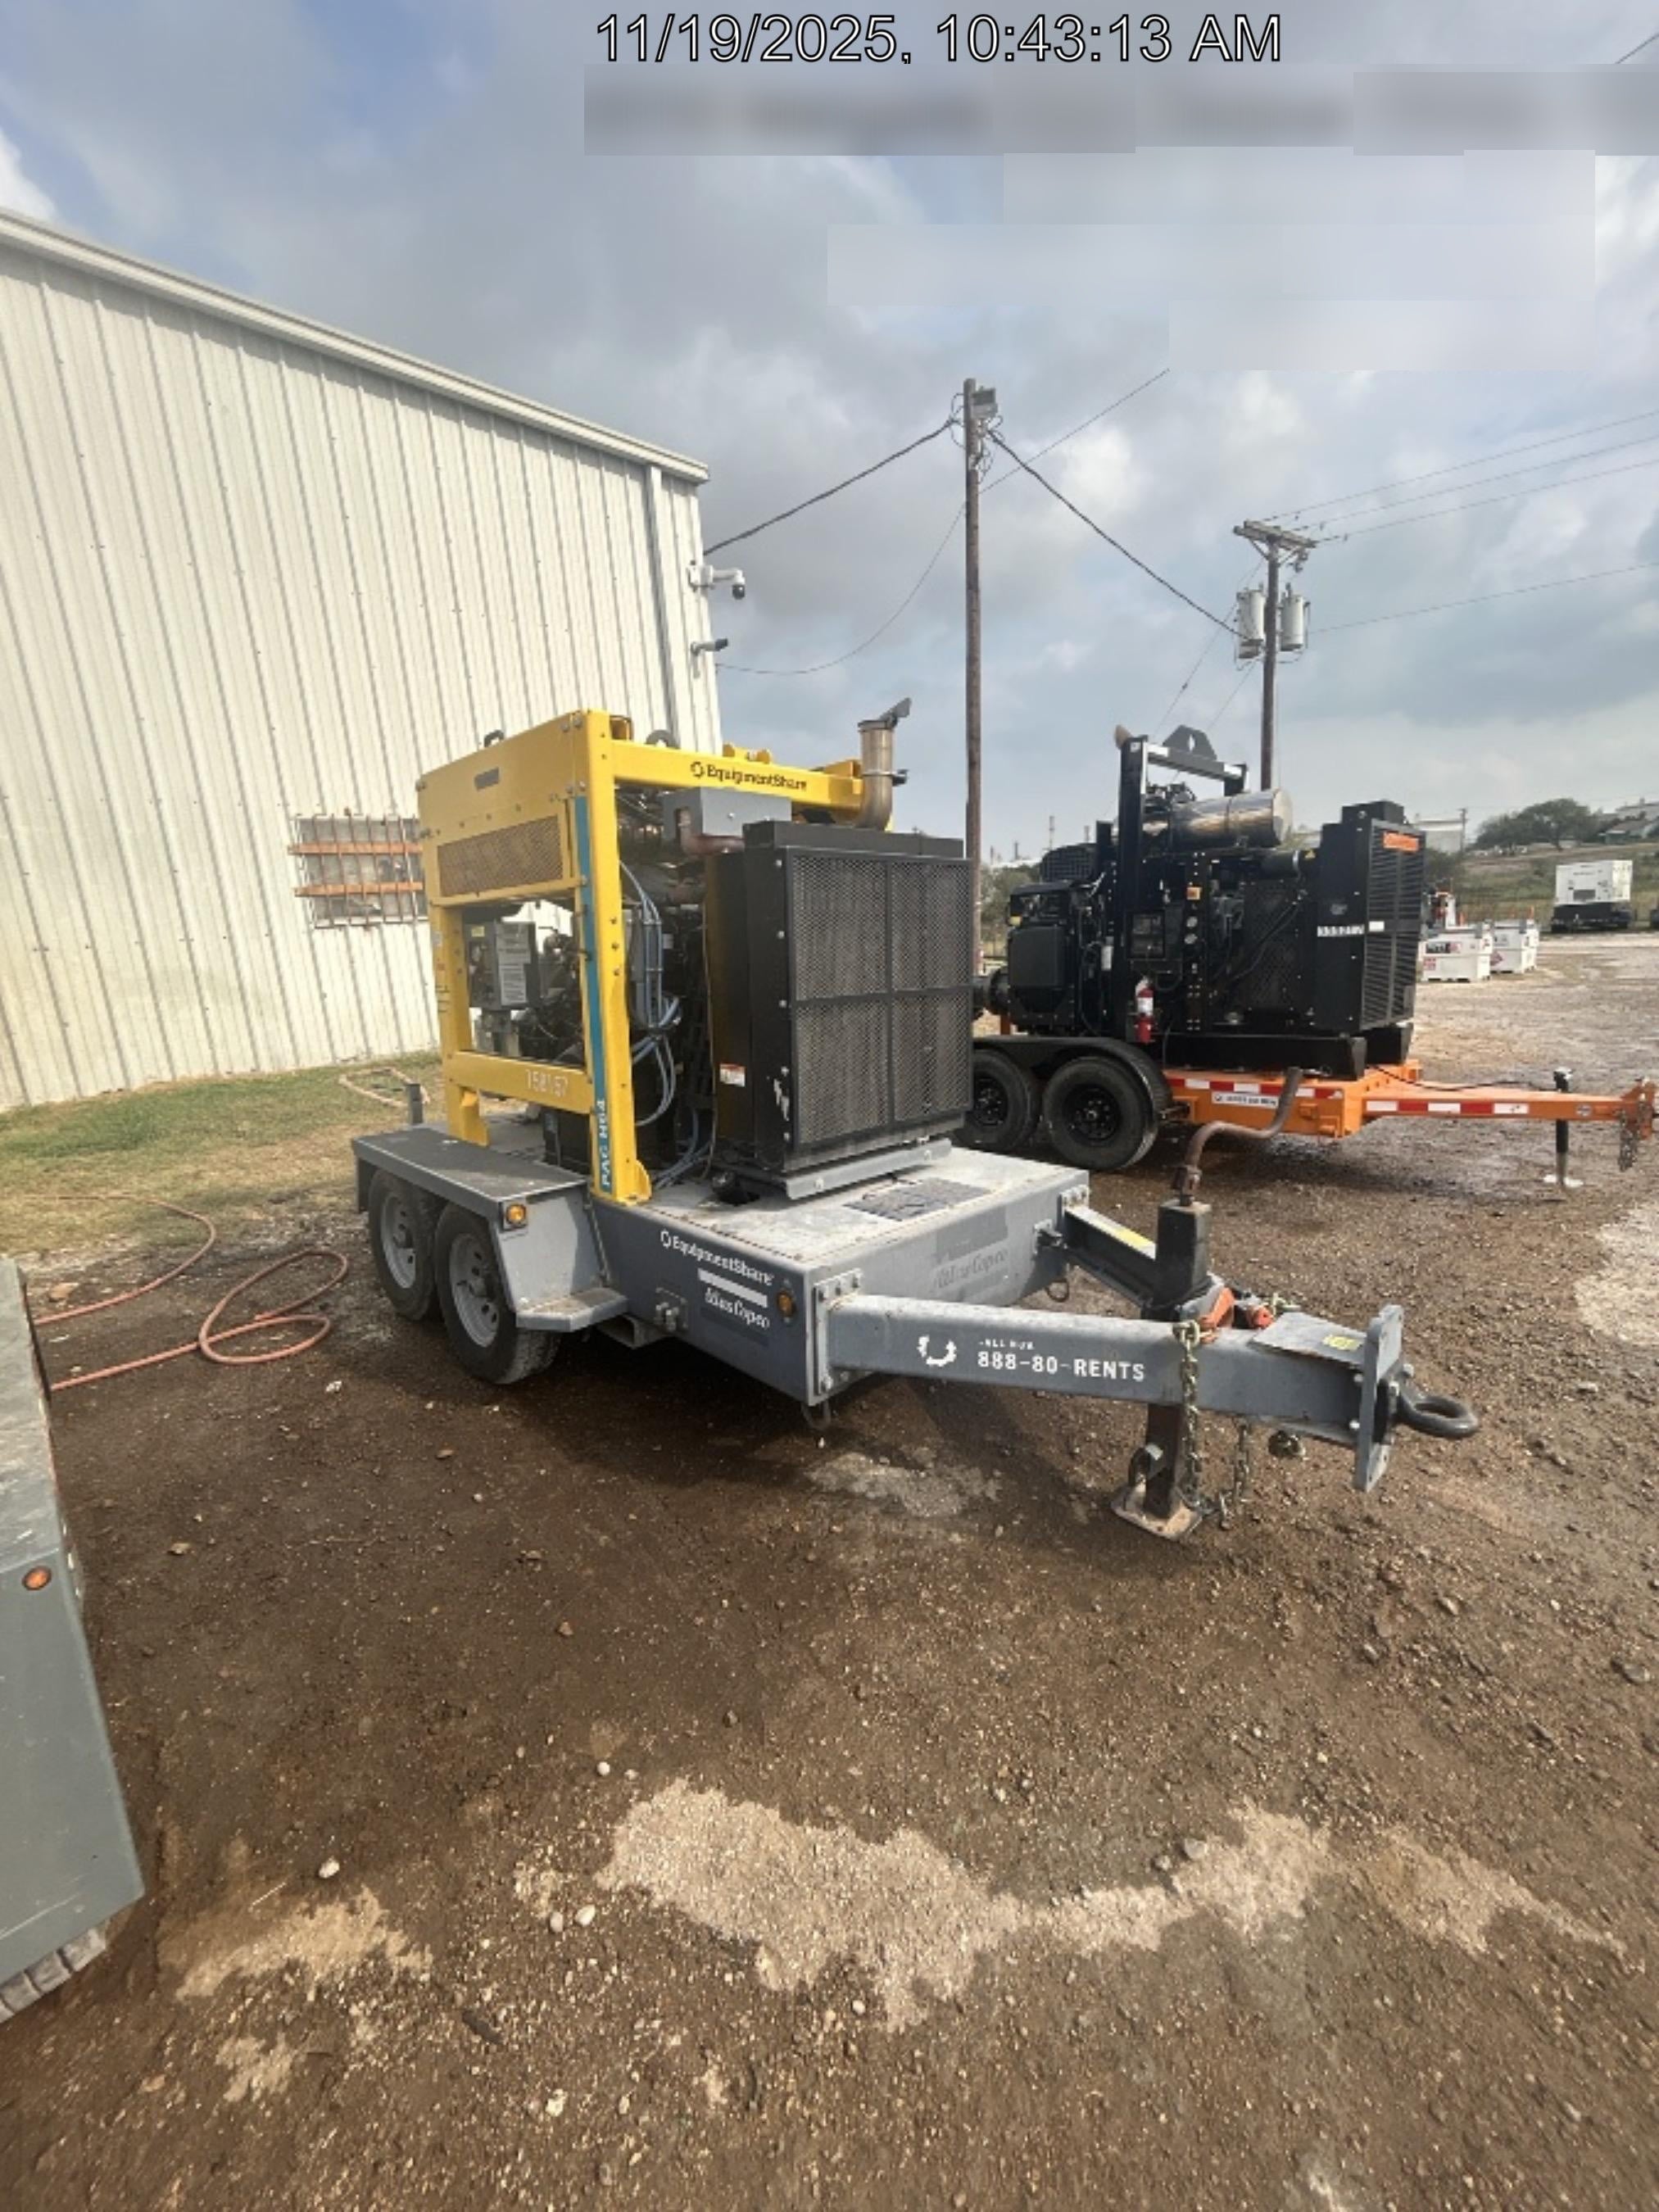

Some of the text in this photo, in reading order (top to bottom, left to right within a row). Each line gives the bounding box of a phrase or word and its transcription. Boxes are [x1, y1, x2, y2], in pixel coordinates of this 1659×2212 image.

[706, 764, 807, 791] EquipmentShare
[673, 1235, 773, 1285] EquipmentShare
[977, 1350, 1145, 1382] 888-80-RENTS
